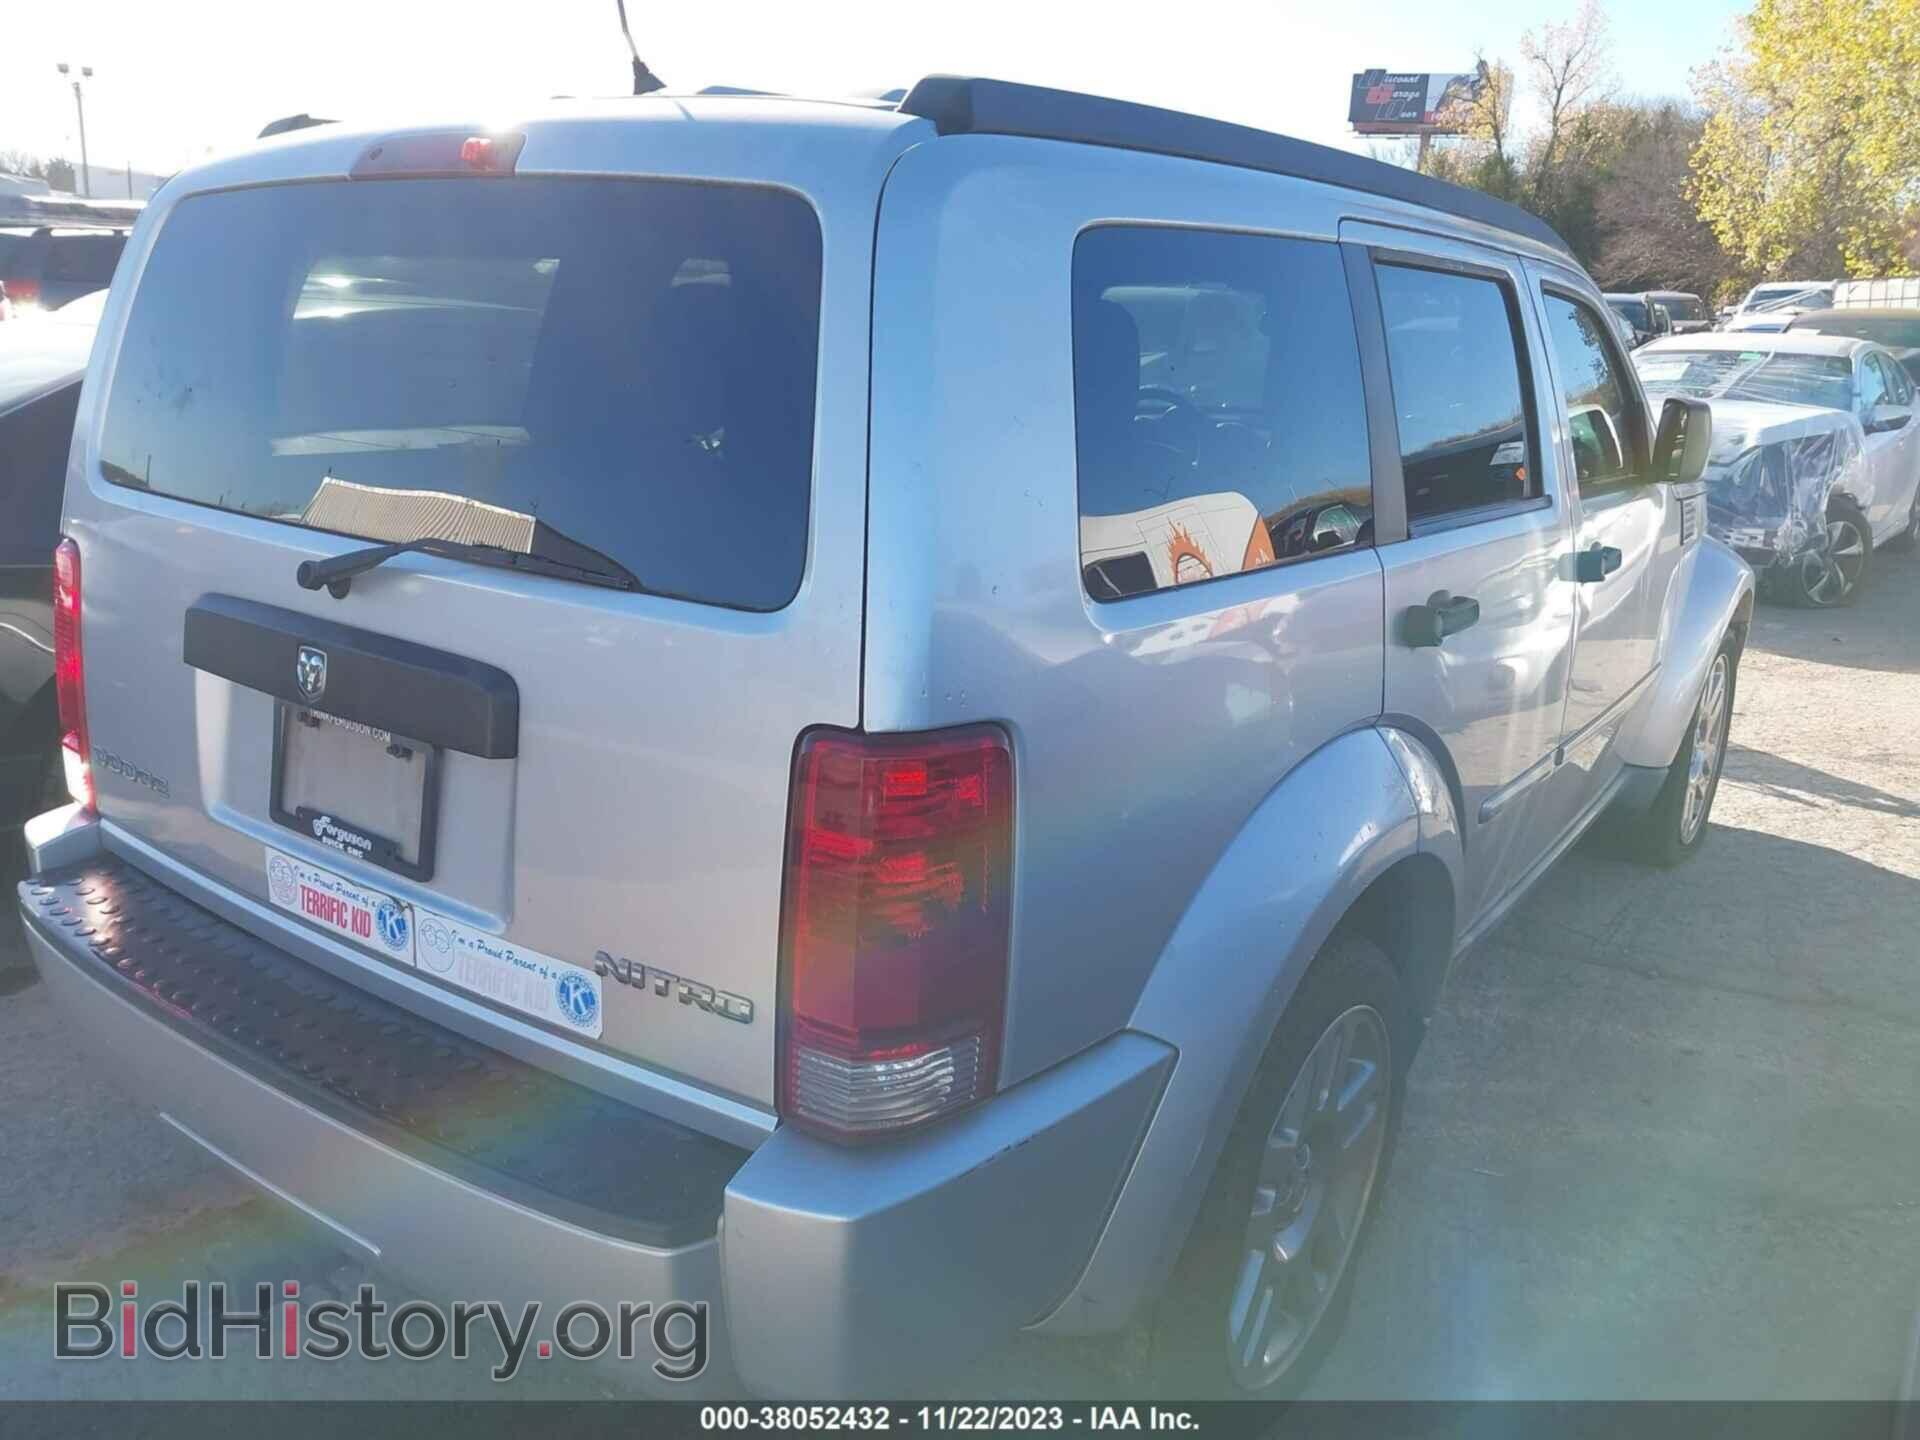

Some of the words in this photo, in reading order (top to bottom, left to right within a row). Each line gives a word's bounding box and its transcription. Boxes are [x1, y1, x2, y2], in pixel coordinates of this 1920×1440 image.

[313, 815, 372, 851] Ferguson
[314, 873, 334, 891] Proud
[336, 882, 360, 901] Parent
[299, 884, 348, 929] TERRIFIC
[351, 906, 372, 938] KID
[476, 939, 504, 959] Proud
[505, 950, 537, 972] Parent
[539, 965, 549, 981] of
[594, 949, 755, 1024] NITRO
